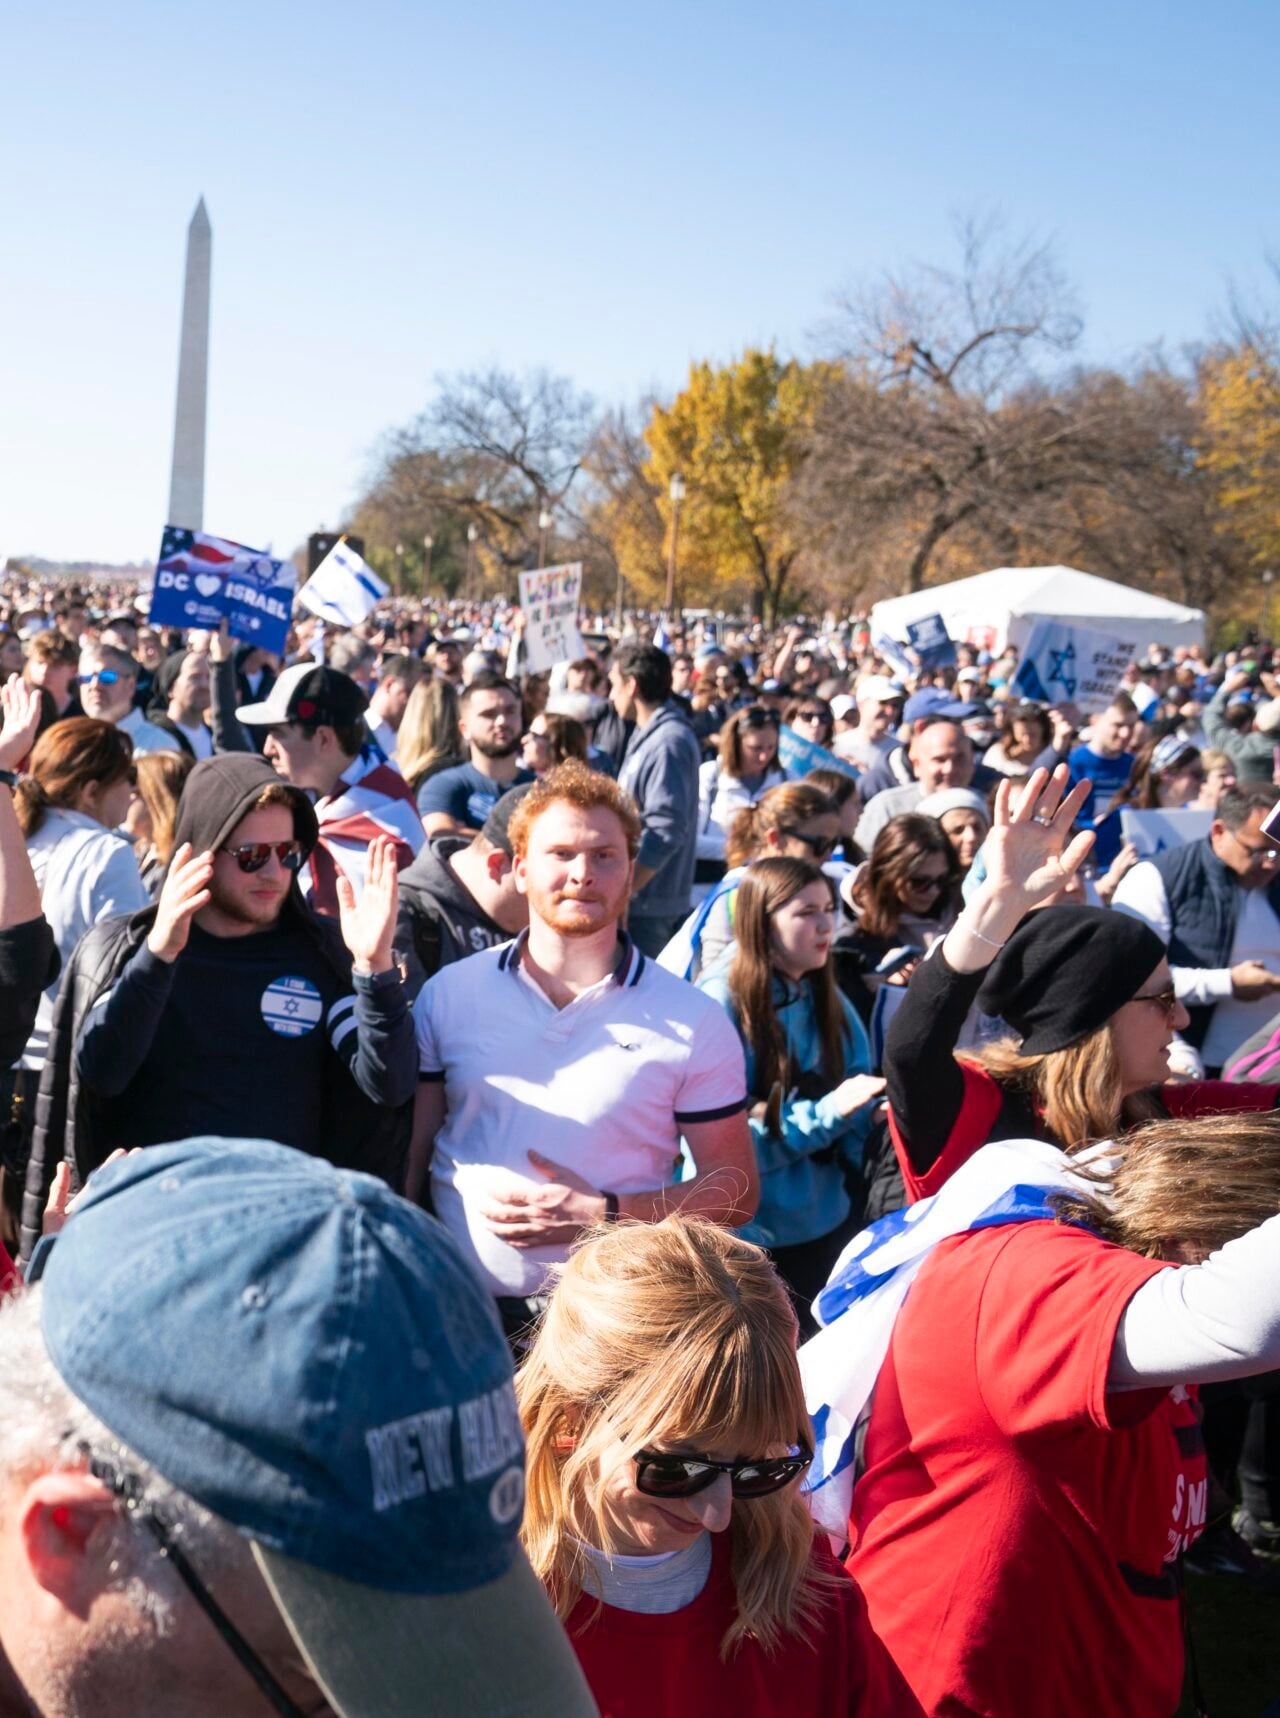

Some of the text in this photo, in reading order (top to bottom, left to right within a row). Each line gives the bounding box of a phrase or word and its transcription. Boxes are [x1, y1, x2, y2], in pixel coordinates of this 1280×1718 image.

[158, 570, 191, 591] DC
[224, 581, 288, 622] ISRAEL
[365, 1405, 454, 1513] NEW
